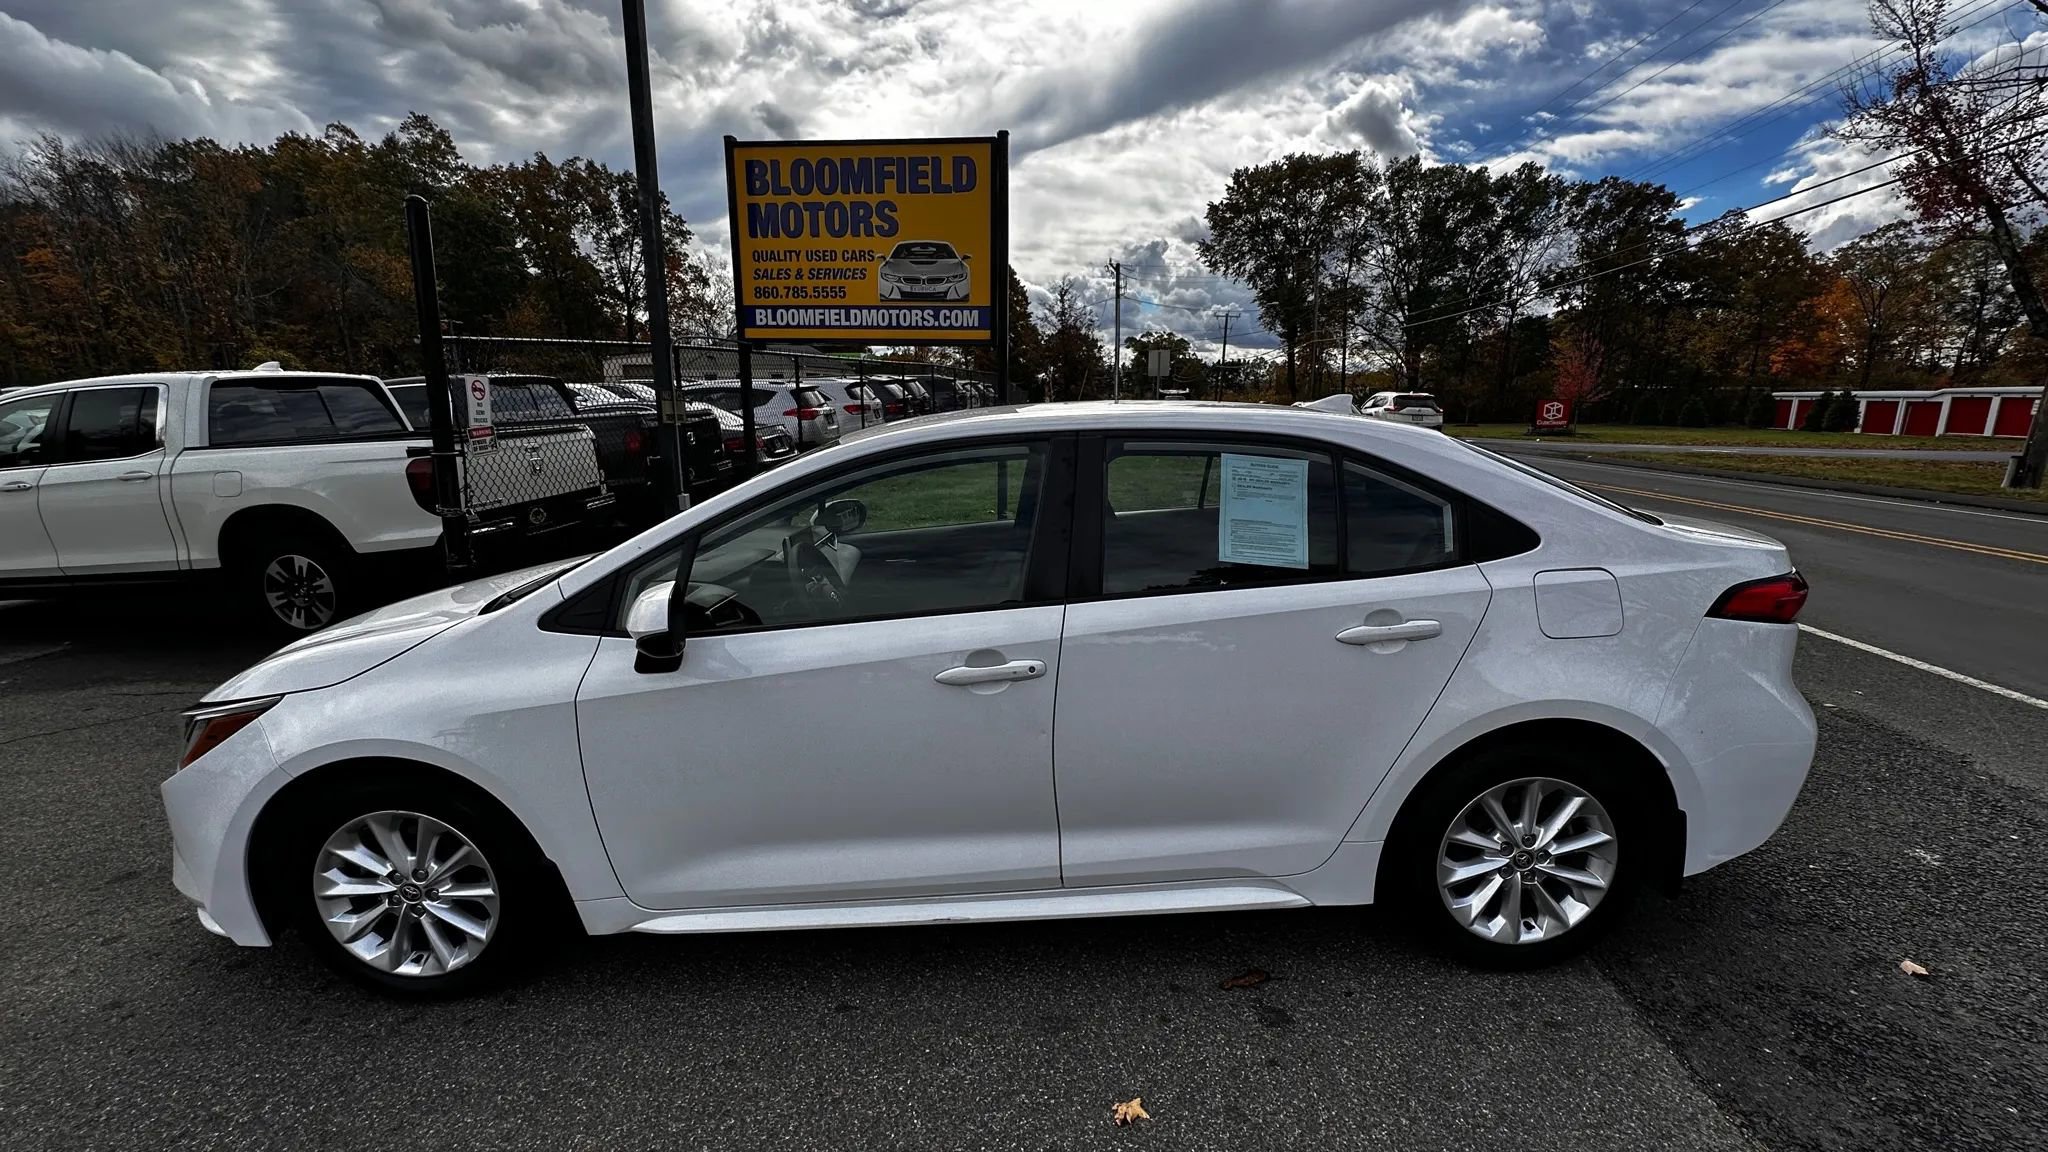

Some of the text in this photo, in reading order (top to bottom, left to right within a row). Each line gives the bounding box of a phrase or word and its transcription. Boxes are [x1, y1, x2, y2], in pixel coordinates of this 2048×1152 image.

[745, 156, 977, 196] BLOOMFIELD
[747, 201, 899, 238] MOTORS
[752, 250, 875, 263] QUALITY USED CARS
[753, 268, 867, 280] SALES & SERVICES
[754, 286, 847, 299] 860.785.5555
[755, 308, 979, 327] BLOOMFIELDMOTORS.COM
